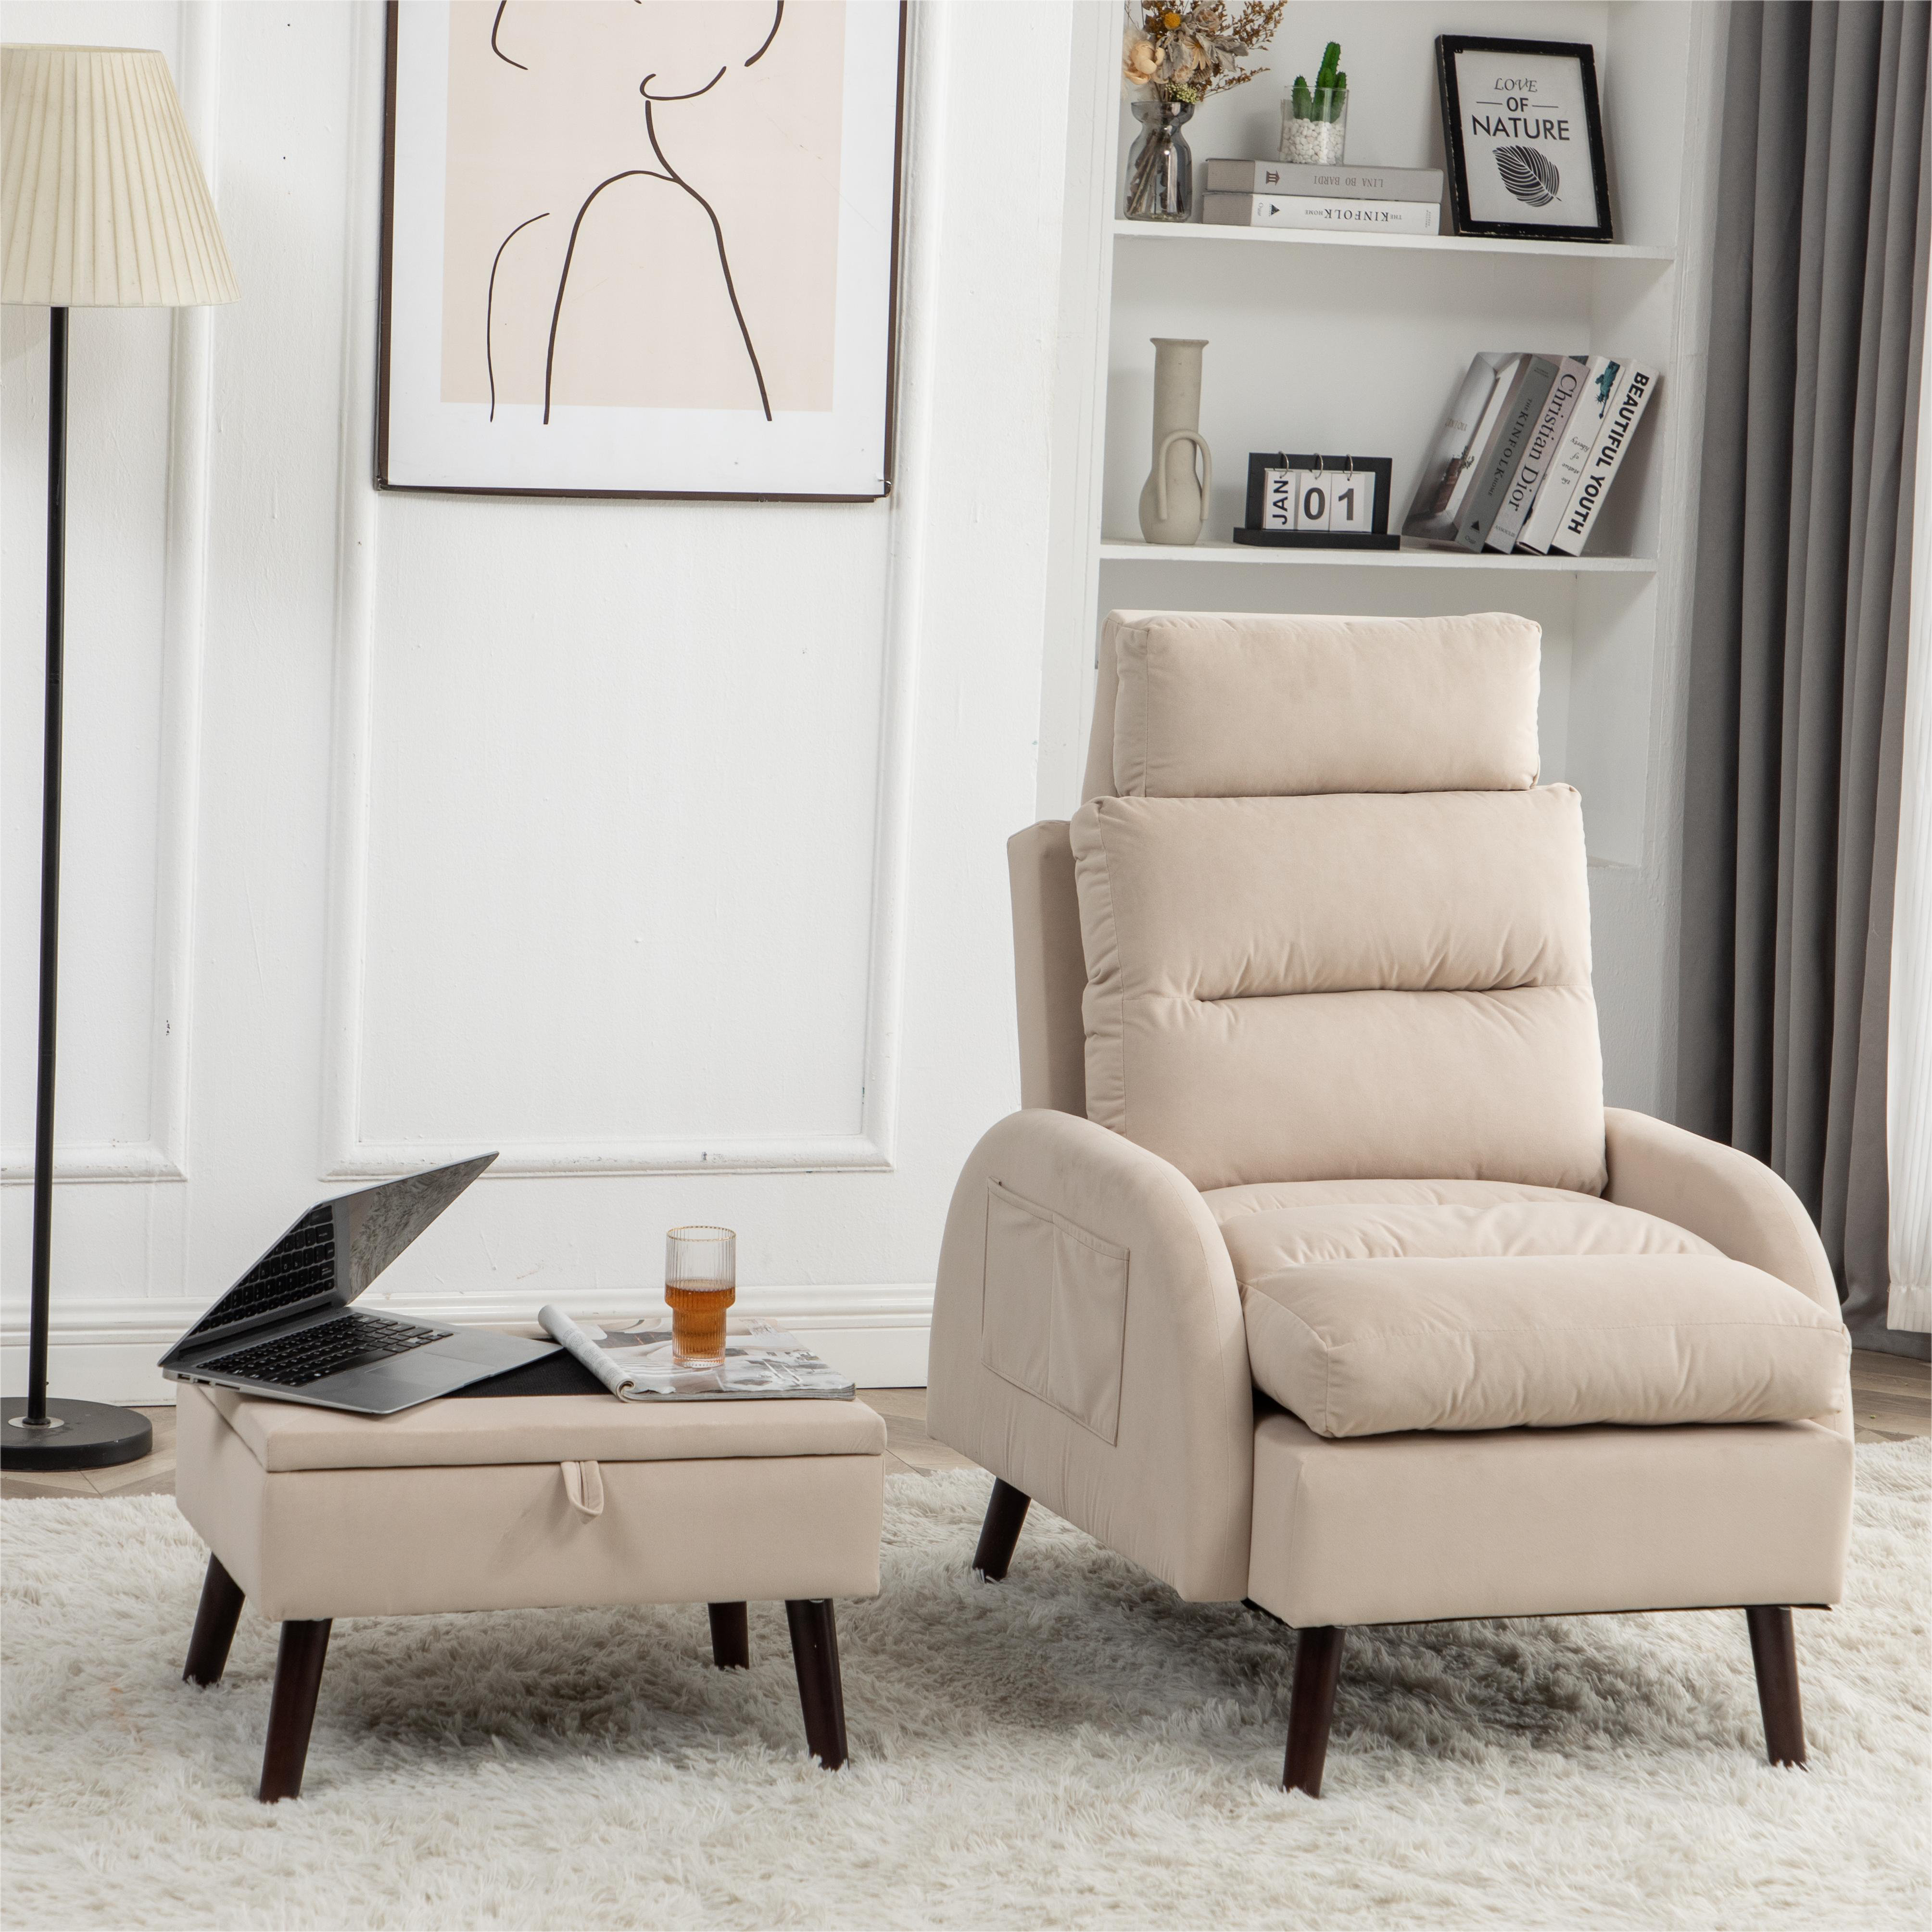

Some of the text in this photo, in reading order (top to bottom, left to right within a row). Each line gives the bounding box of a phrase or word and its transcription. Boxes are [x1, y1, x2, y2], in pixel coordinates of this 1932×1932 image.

[1494, 77, 1538, 92] LOVE
[1506, 97, 1529, 112] OF
[1472, 114, 1570, 140] NATURE
[1313, 175, 1384, 188] LINA BO BARDI
[1325, 208, 1389, 222] KINFOLK
[1494, 411, 1529, 478] KINFOLK
[1508, 374, 1577, 511] Christian Dior
[1568, 372, 1650, 535] BEAUTIFUL YOUTH
[1272, 480, 1289, 525] JAN
